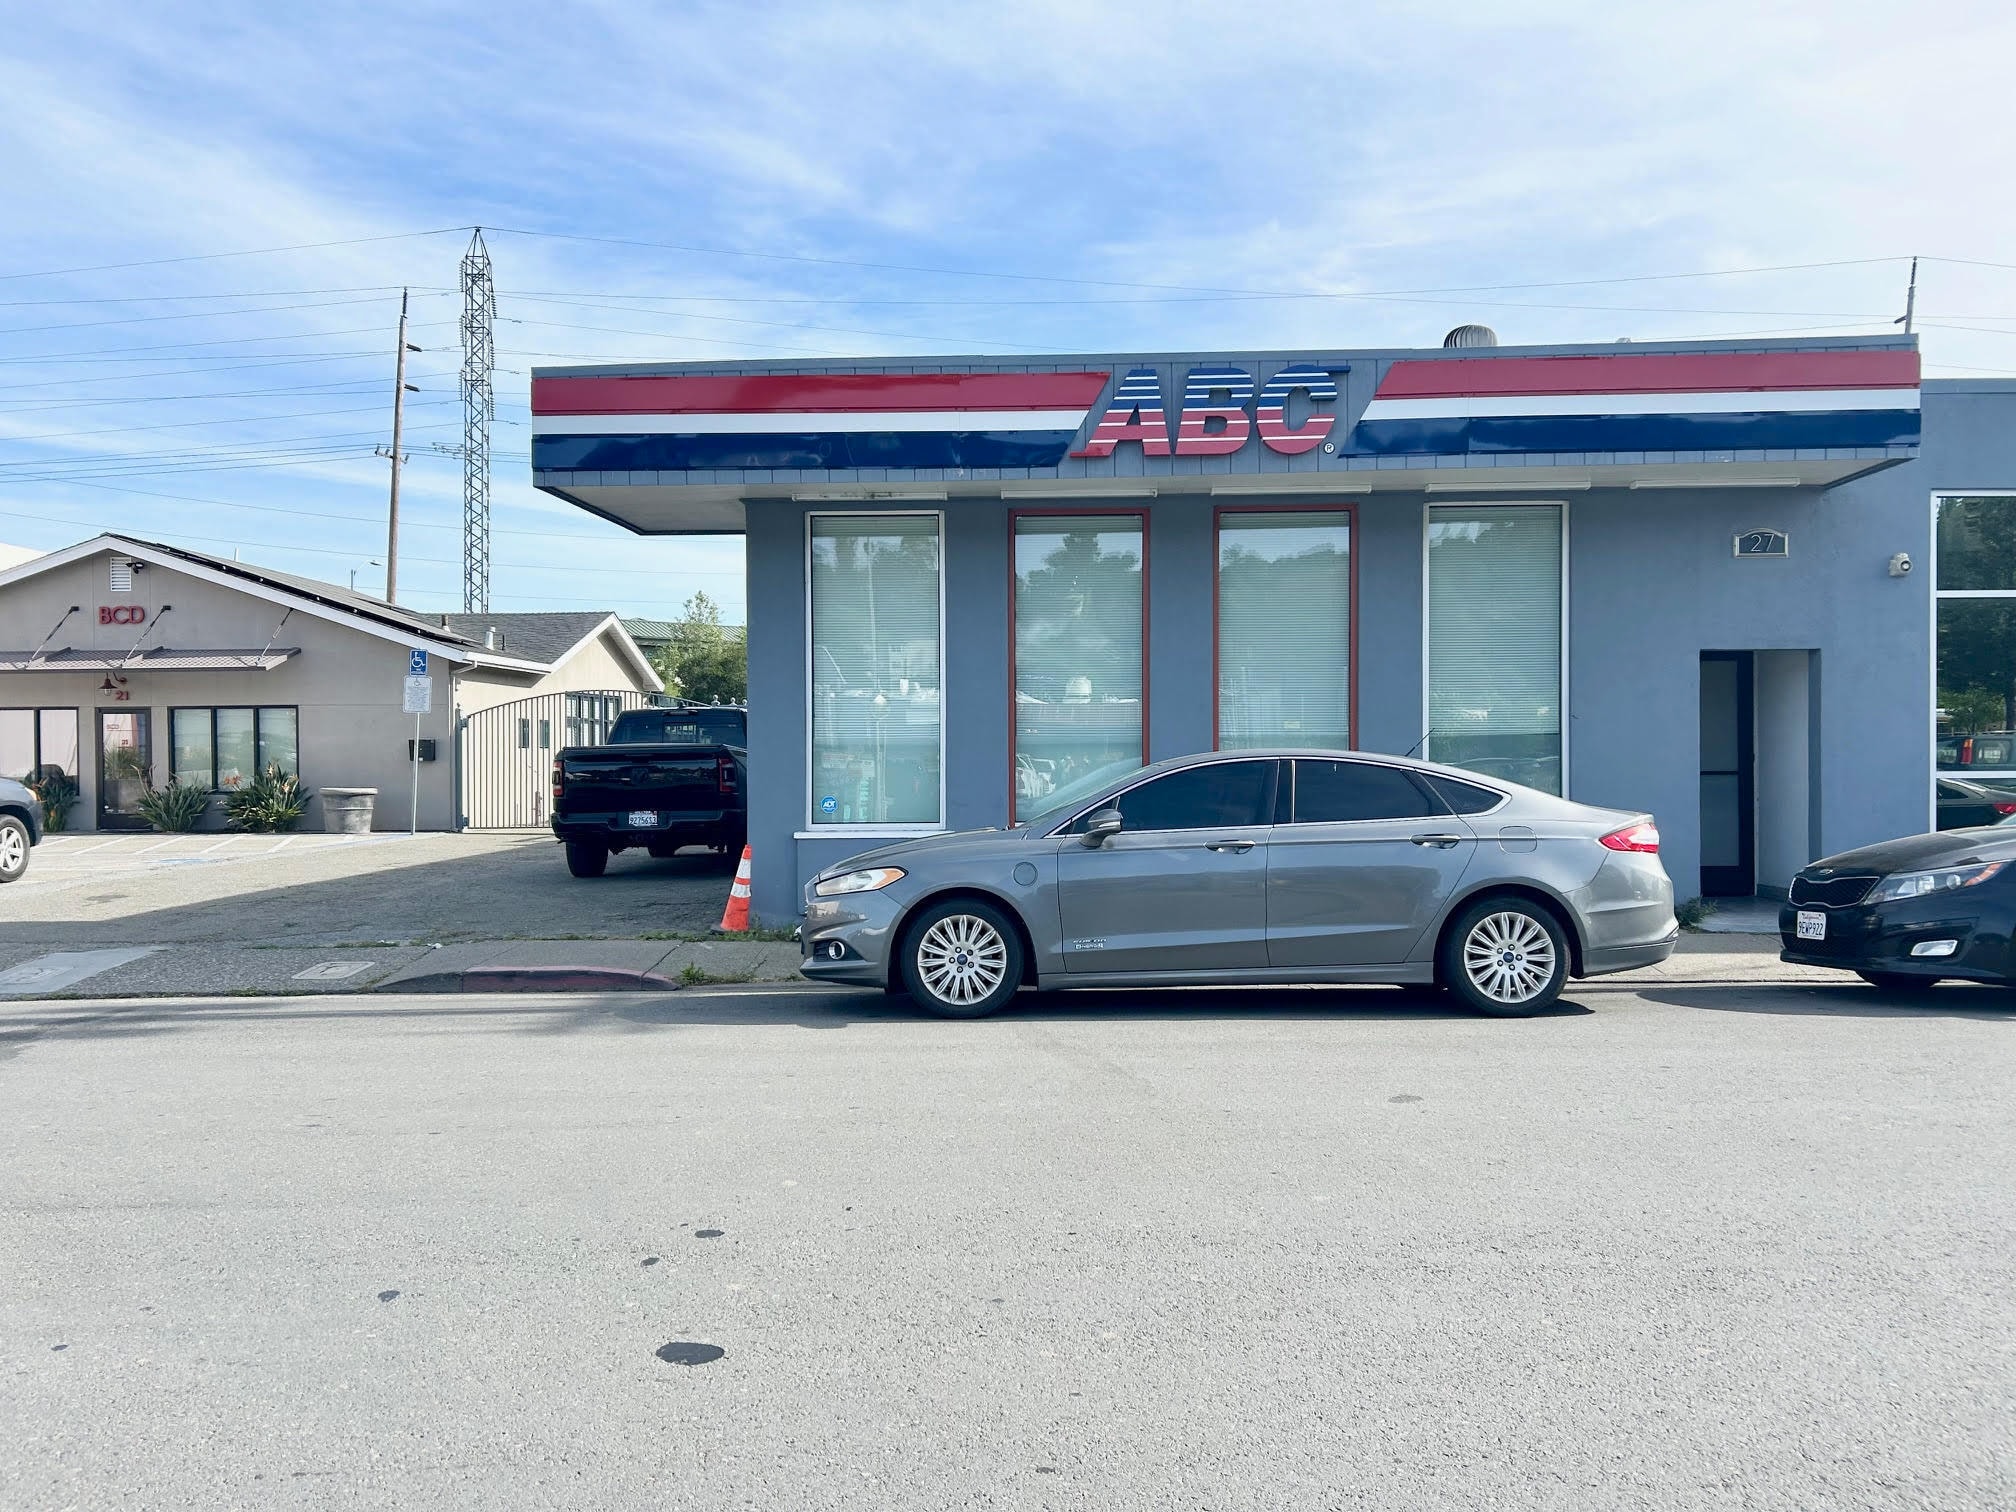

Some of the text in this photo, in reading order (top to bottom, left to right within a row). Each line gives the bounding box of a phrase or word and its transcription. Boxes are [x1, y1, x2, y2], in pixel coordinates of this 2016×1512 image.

[1069, 364, 1351, 458] ABC
[1750, 533, 1775, 552] 27
[99, 605, 146, 625] BCD
[115, 690, 130, 701] 21
